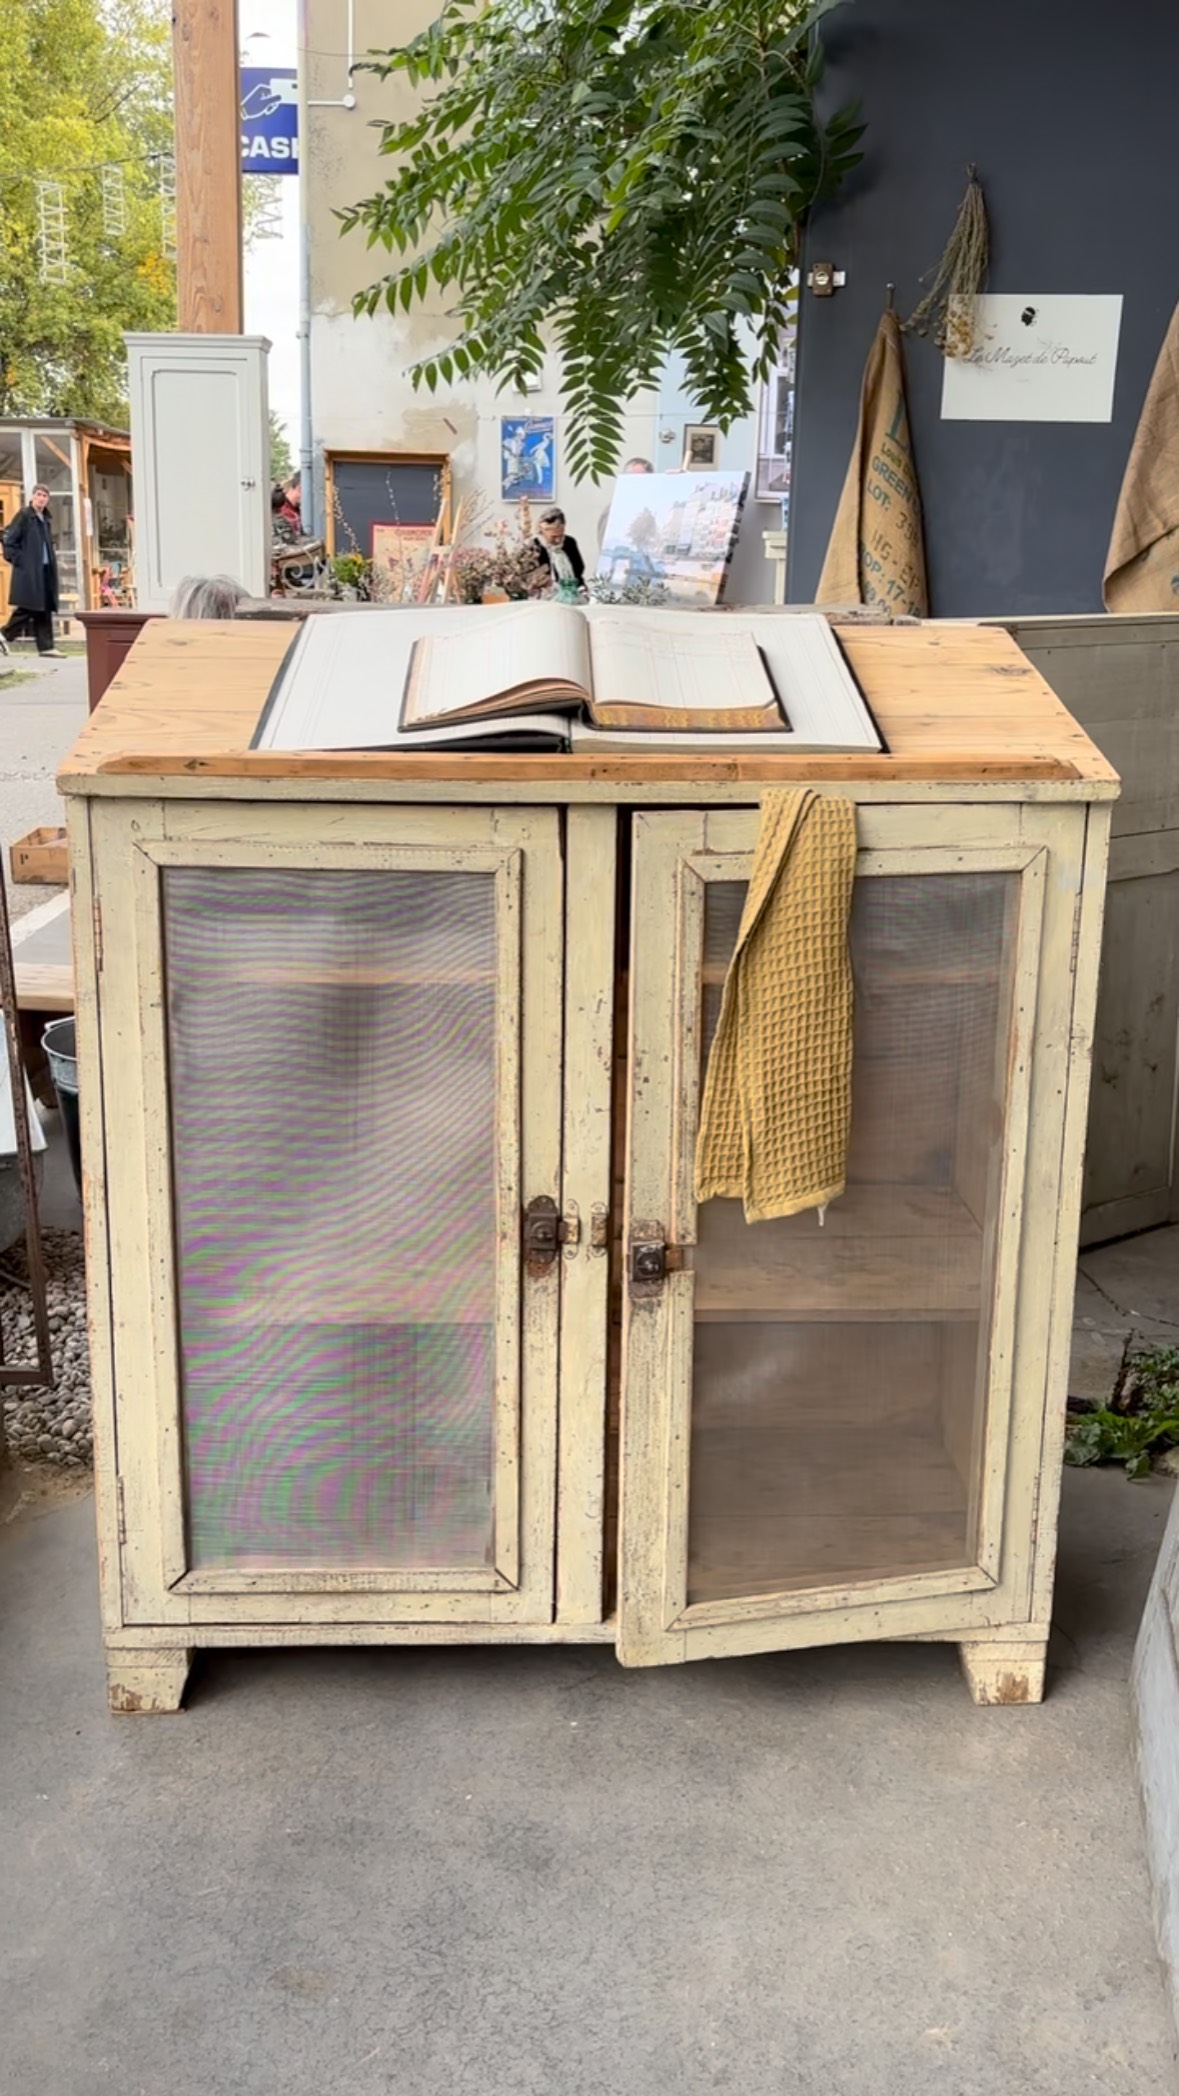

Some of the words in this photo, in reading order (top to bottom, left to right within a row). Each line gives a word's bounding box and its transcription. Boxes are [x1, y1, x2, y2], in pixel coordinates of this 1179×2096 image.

[866, 478, 891, 511] LOT:
[872, 455, 912, 503] GREEN
[861, 543, 886, 583] OP:
